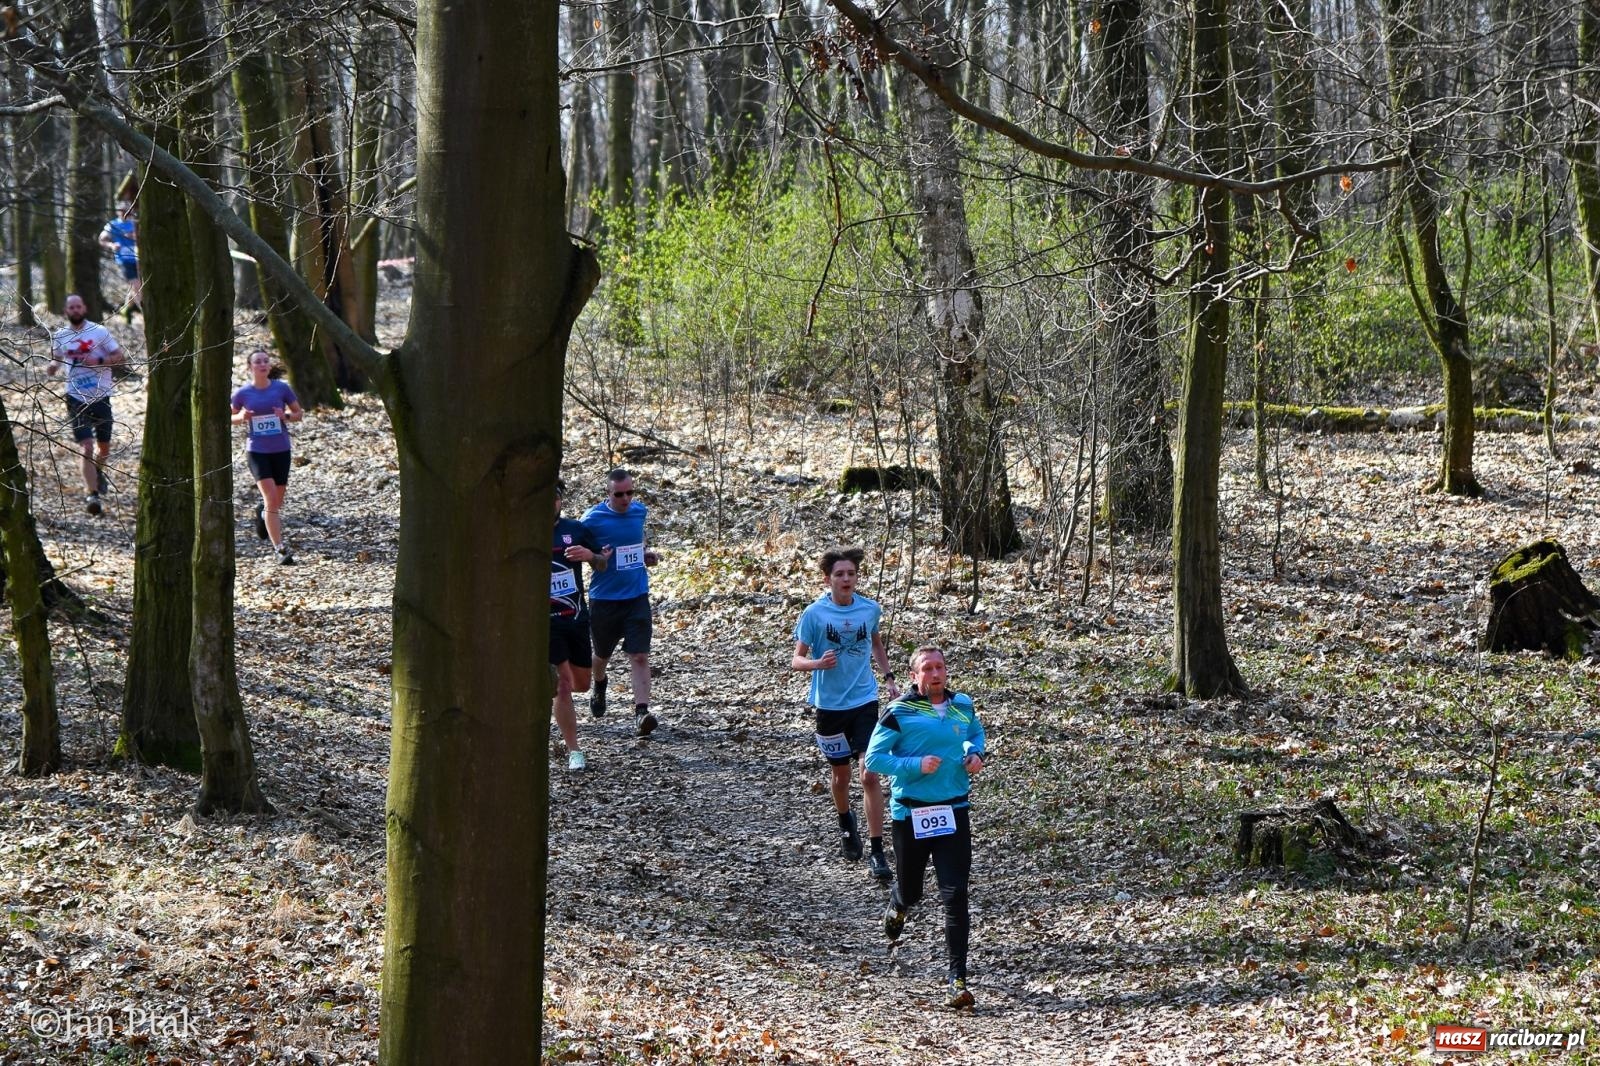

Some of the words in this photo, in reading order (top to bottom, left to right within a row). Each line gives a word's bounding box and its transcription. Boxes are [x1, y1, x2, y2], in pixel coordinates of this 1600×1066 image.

[257, 421, 276, 430] 079
[624, 553, 638, 563] 115
[552, 579, 569, 590] 116
[822, 742, 841, 752] 007
[921, 815, 947, 829] 093
